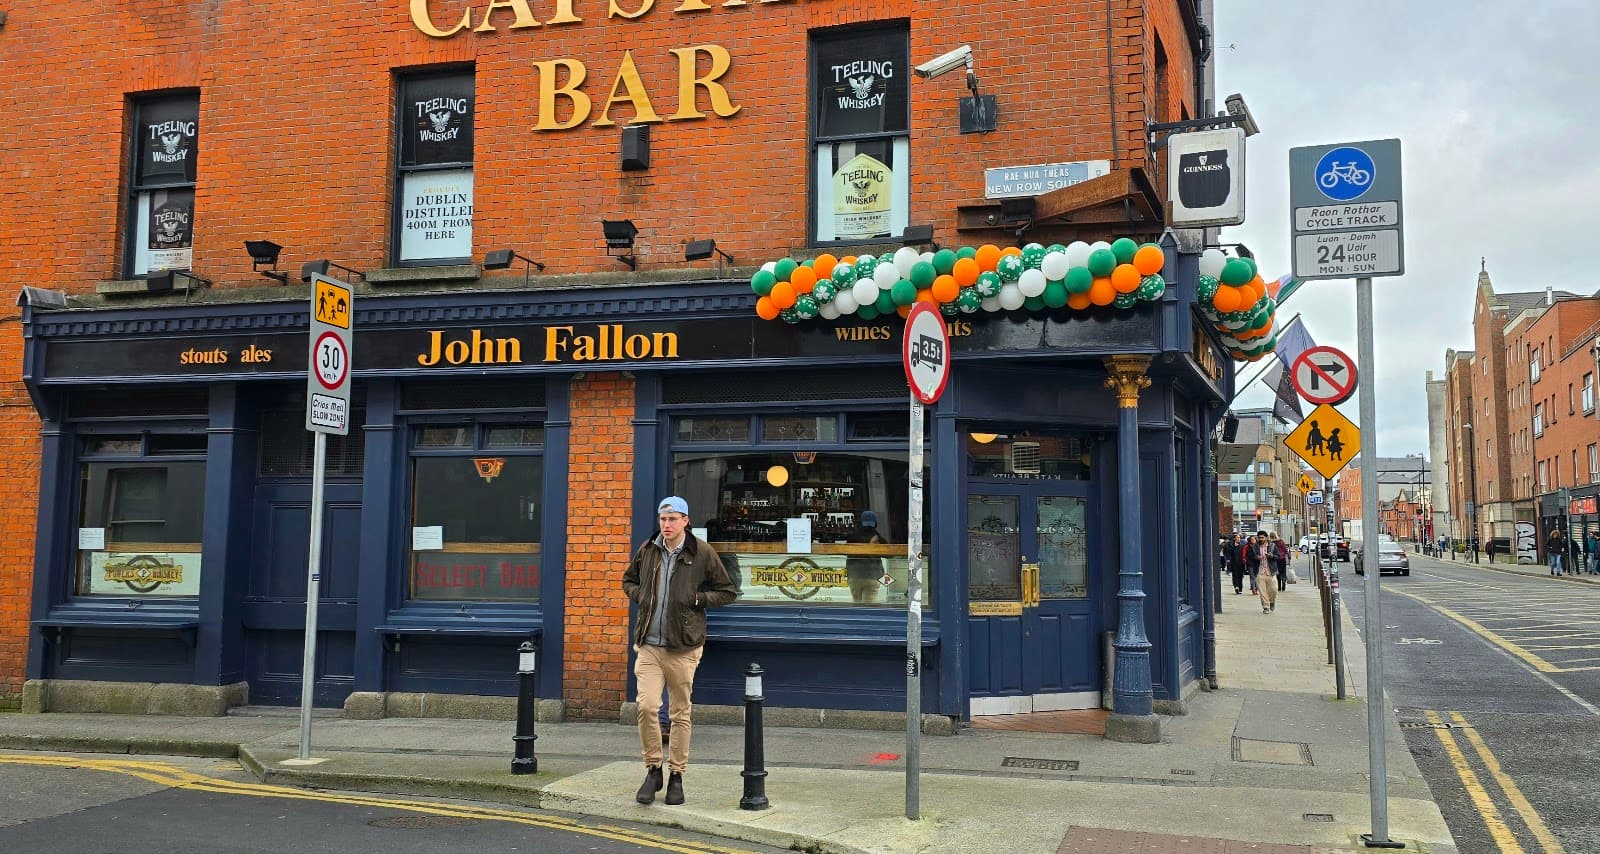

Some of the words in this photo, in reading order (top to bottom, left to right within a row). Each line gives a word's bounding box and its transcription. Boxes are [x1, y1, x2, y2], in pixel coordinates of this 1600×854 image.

[832, 61, 893, 82] TEELING
[531, 44, 742, 131] BAR
[838, 93, 885, 109] WHISKEY
[416, 98, 467, 118] TEELING
[149, 121, 195, 139] TEELING
[420, 127, 459, 142] WHISKEY
[153, 149, 188, 162] WHISKEY
[1004, 172, 1019, 181] RAE
[1024, 170, 1039, 179] NUA
[1044, 168, 1069, 178] THEAS
[1184, 164, 1223, 173] GUINNESS
[841, 170, 884, 184] TEELING
[988, 184, 1012, 194] NEW
[1017, 181, 1042, 192] ROW
[416, 194, 467, 205] DUBLIN
[1311, 208, 1338, 217] Raon
[1343, 205, 1381, 215] Rothar
[155, 212, 189, 225] TEELING
[1307, 217, 1343, 228] CYCLE
[1347, 215, 1386, 225] TRACK
[407, 221, 437, 230] 400M
[426, 231, 455, 240] HERE
[1350, 233, 1376, 241] Domh
[1347, 243, 1367, 252] Uair
[1317, 245, 1345, 264] 24
[1348, 253, 1377, 263] HOUR
[1319, 265, 1343, 274] MON
[1353, 264, 1375, 272] SUN
[835, 325, 891, 342] wines
[418, 329, 523, 366] John
[542, 324, 680, 362] Fallon
[923, 341, 941, 360] 3.5t
[180, 347, 228, 364] stouts
[240, 344, 273, 363] ales
[322, 345, 339, 370] 30
[323, 370, 338, 381] km/h
[313, 410, 329, 421] SLOW
[330, 412, 344, 423] ZONE
[811, 573, 843, 584] WHISKEY
